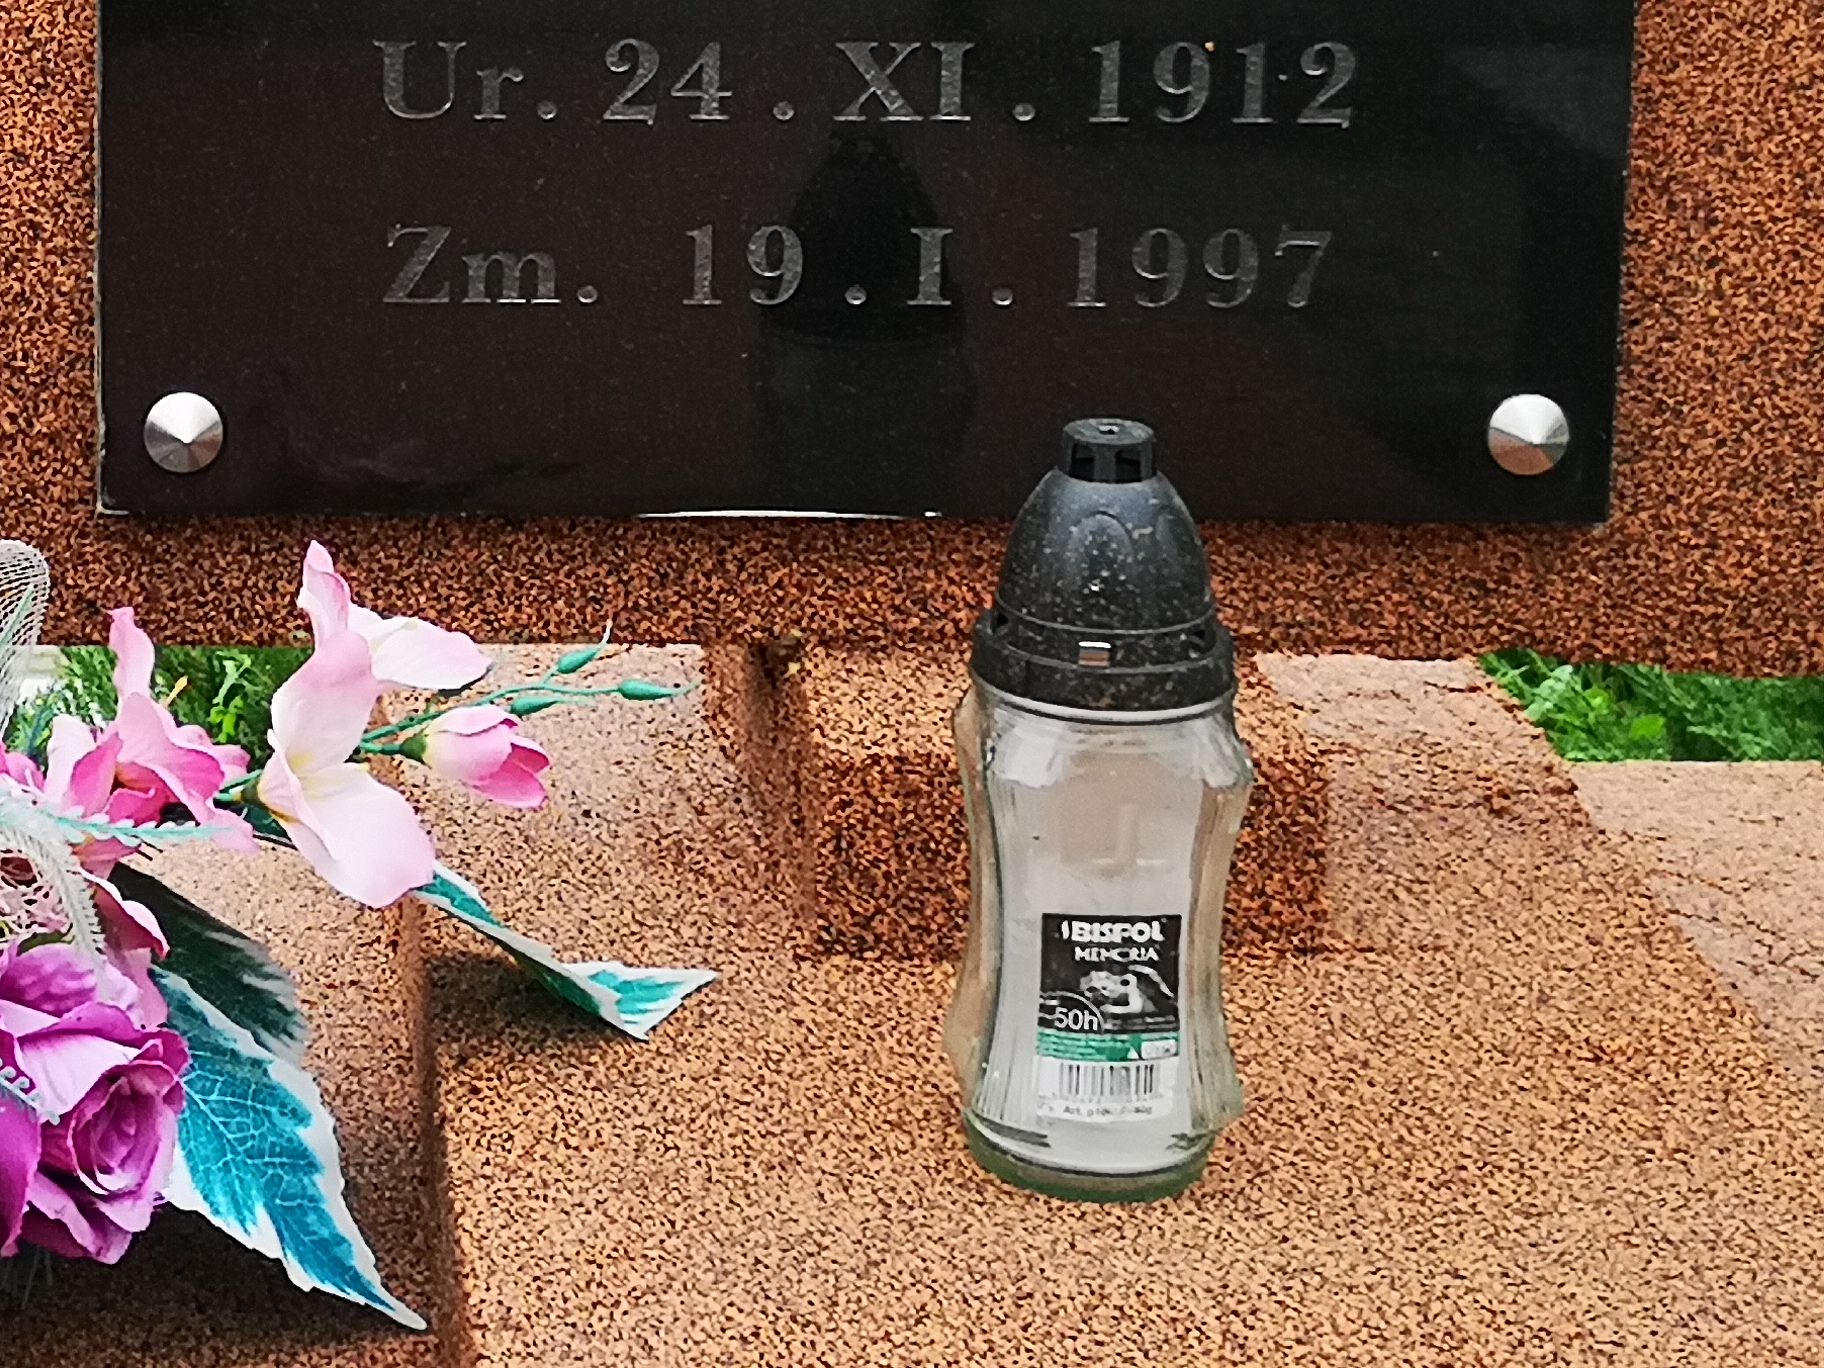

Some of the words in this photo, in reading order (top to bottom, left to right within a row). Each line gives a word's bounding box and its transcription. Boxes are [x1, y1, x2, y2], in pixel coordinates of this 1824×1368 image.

[373, 40, 559, 124] Ur.
[383, 224, 600, 307] Zm.
[1070, 920, 1165, 944] BISPOL
[1054, 1006, 1098, 1031] 50h
